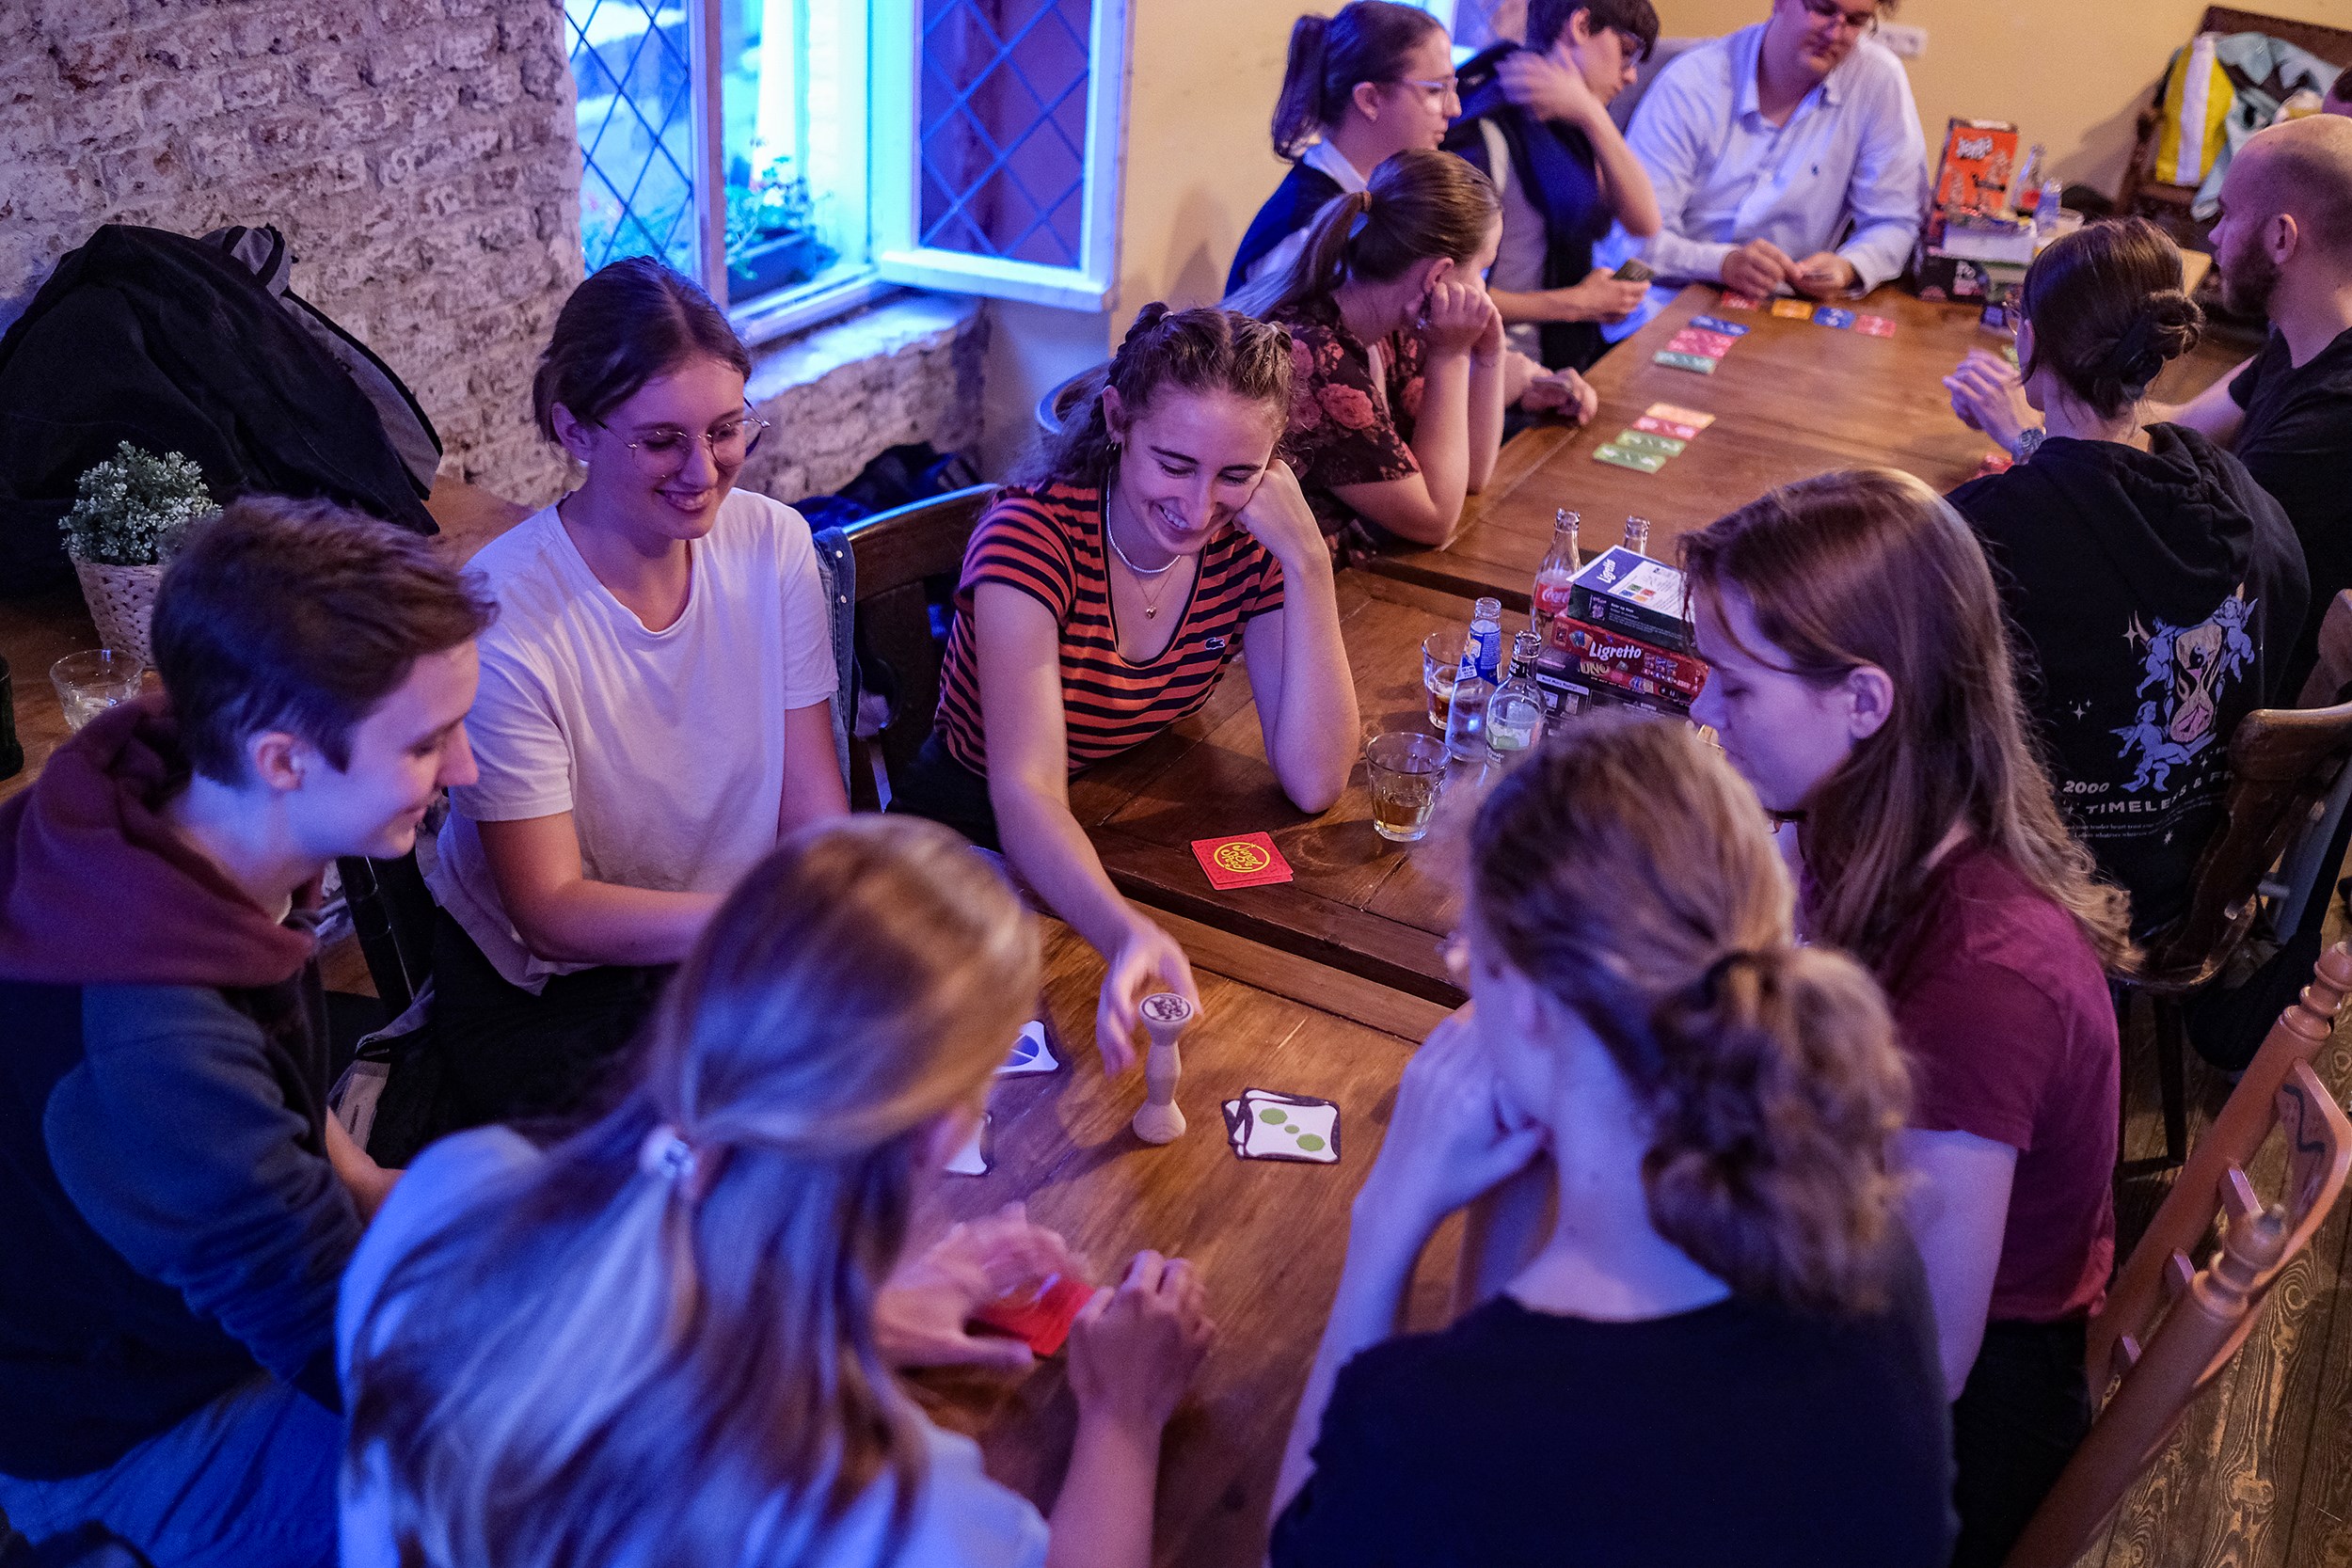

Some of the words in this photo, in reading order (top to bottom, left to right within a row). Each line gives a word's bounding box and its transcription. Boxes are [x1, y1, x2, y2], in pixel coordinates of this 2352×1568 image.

[1589, 641, 1642, 661] Ligretto
[1580, 661, 1610, 675] UNO
[2062, 780, 2110, 794] 2000
[1220, 849, 1253, 869] Speed
